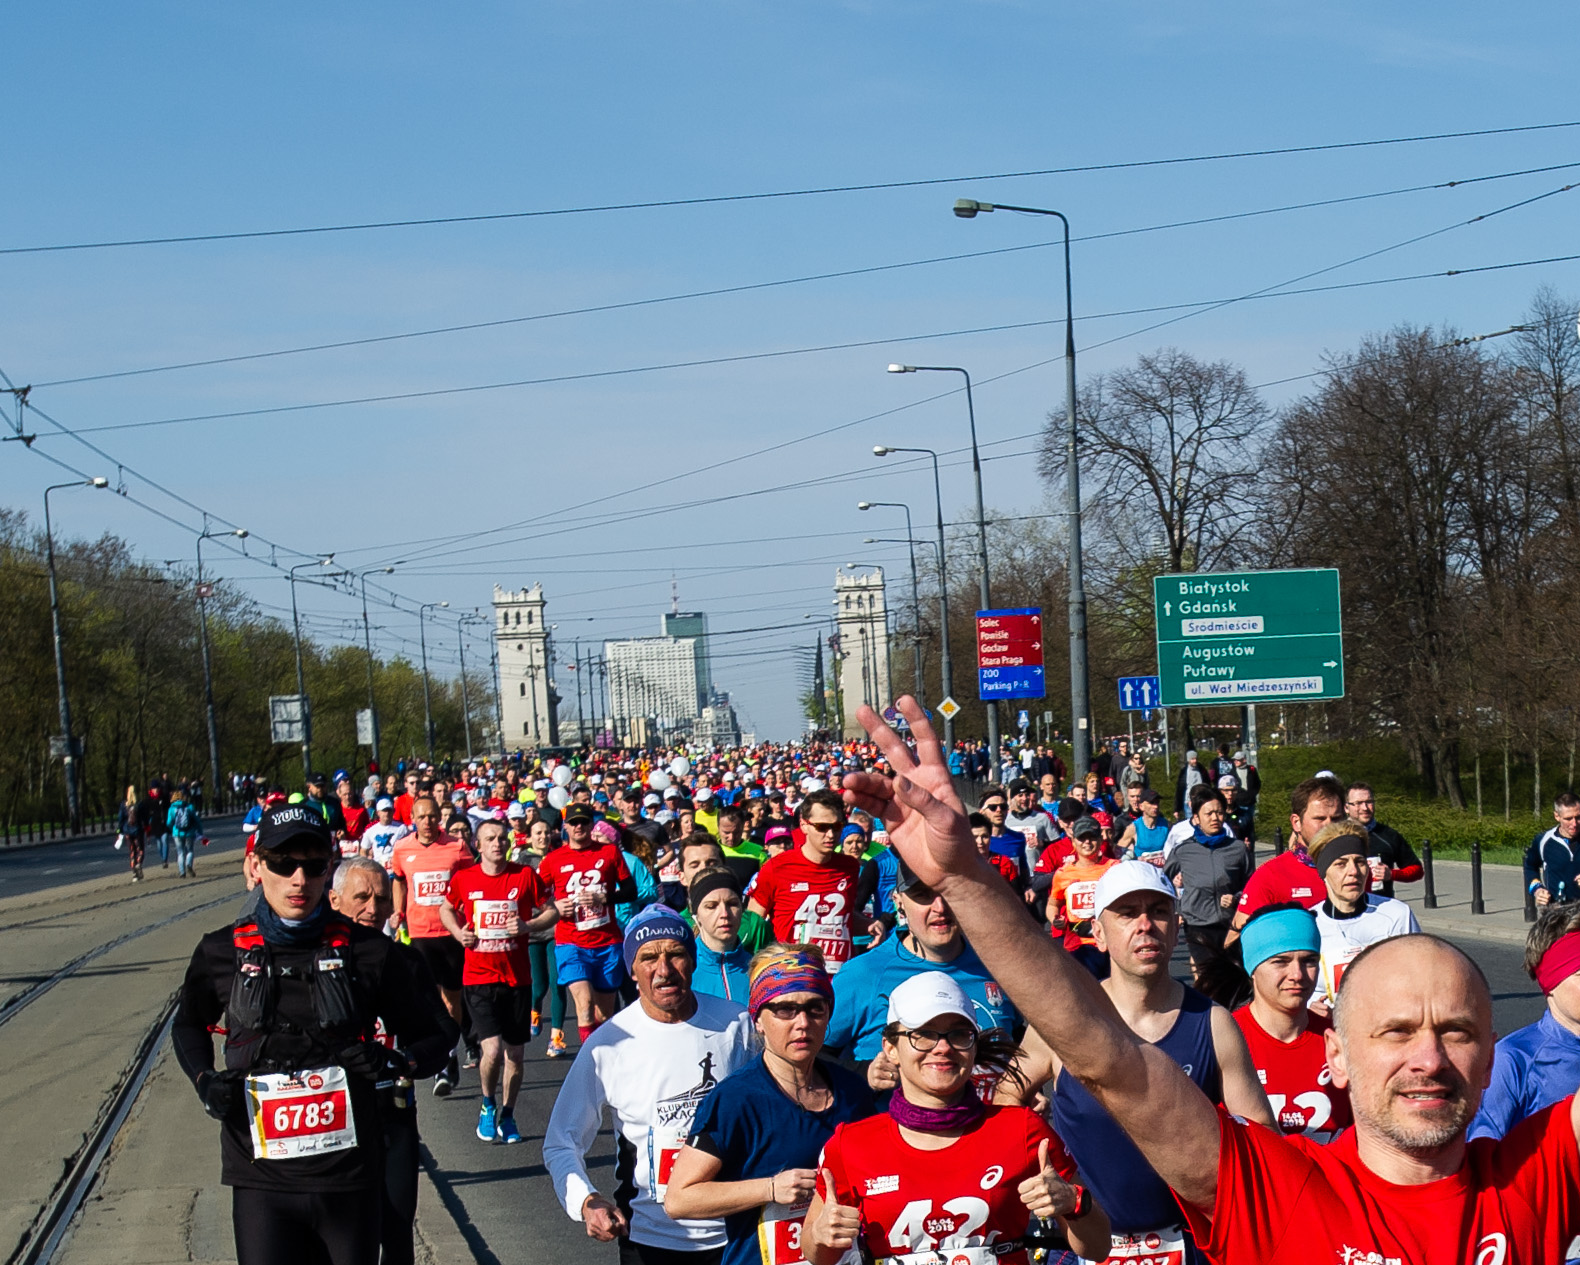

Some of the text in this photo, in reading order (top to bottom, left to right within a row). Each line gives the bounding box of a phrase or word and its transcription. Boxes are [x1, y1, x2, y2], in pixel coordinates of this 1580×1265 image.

[1178, 579, 1250, 597] Białystok
[1179, 599, 1238, 614] Gdańsk
[979, 618, 1000, 628] Solec
[1188, 619, 1259, 632] Śródmieście
[1182, 643, 1255, 661] Augustów
[981, 656, 1024, 666] Stara Praga
[983, 669, 999, 678] ZOO
[1183, 664, 1235, 679] Puławy
[983, 681, 1012, 692] Parking
[1191, 679, 1317, 695] ul. Wał Miedzeszyński
[421, 882, 446, 894] 2130
[1076, 892, 1094, 905] 143
[274, 1100, 335, 1132] 6783
[928, 1224, 955, 1234] 2019
